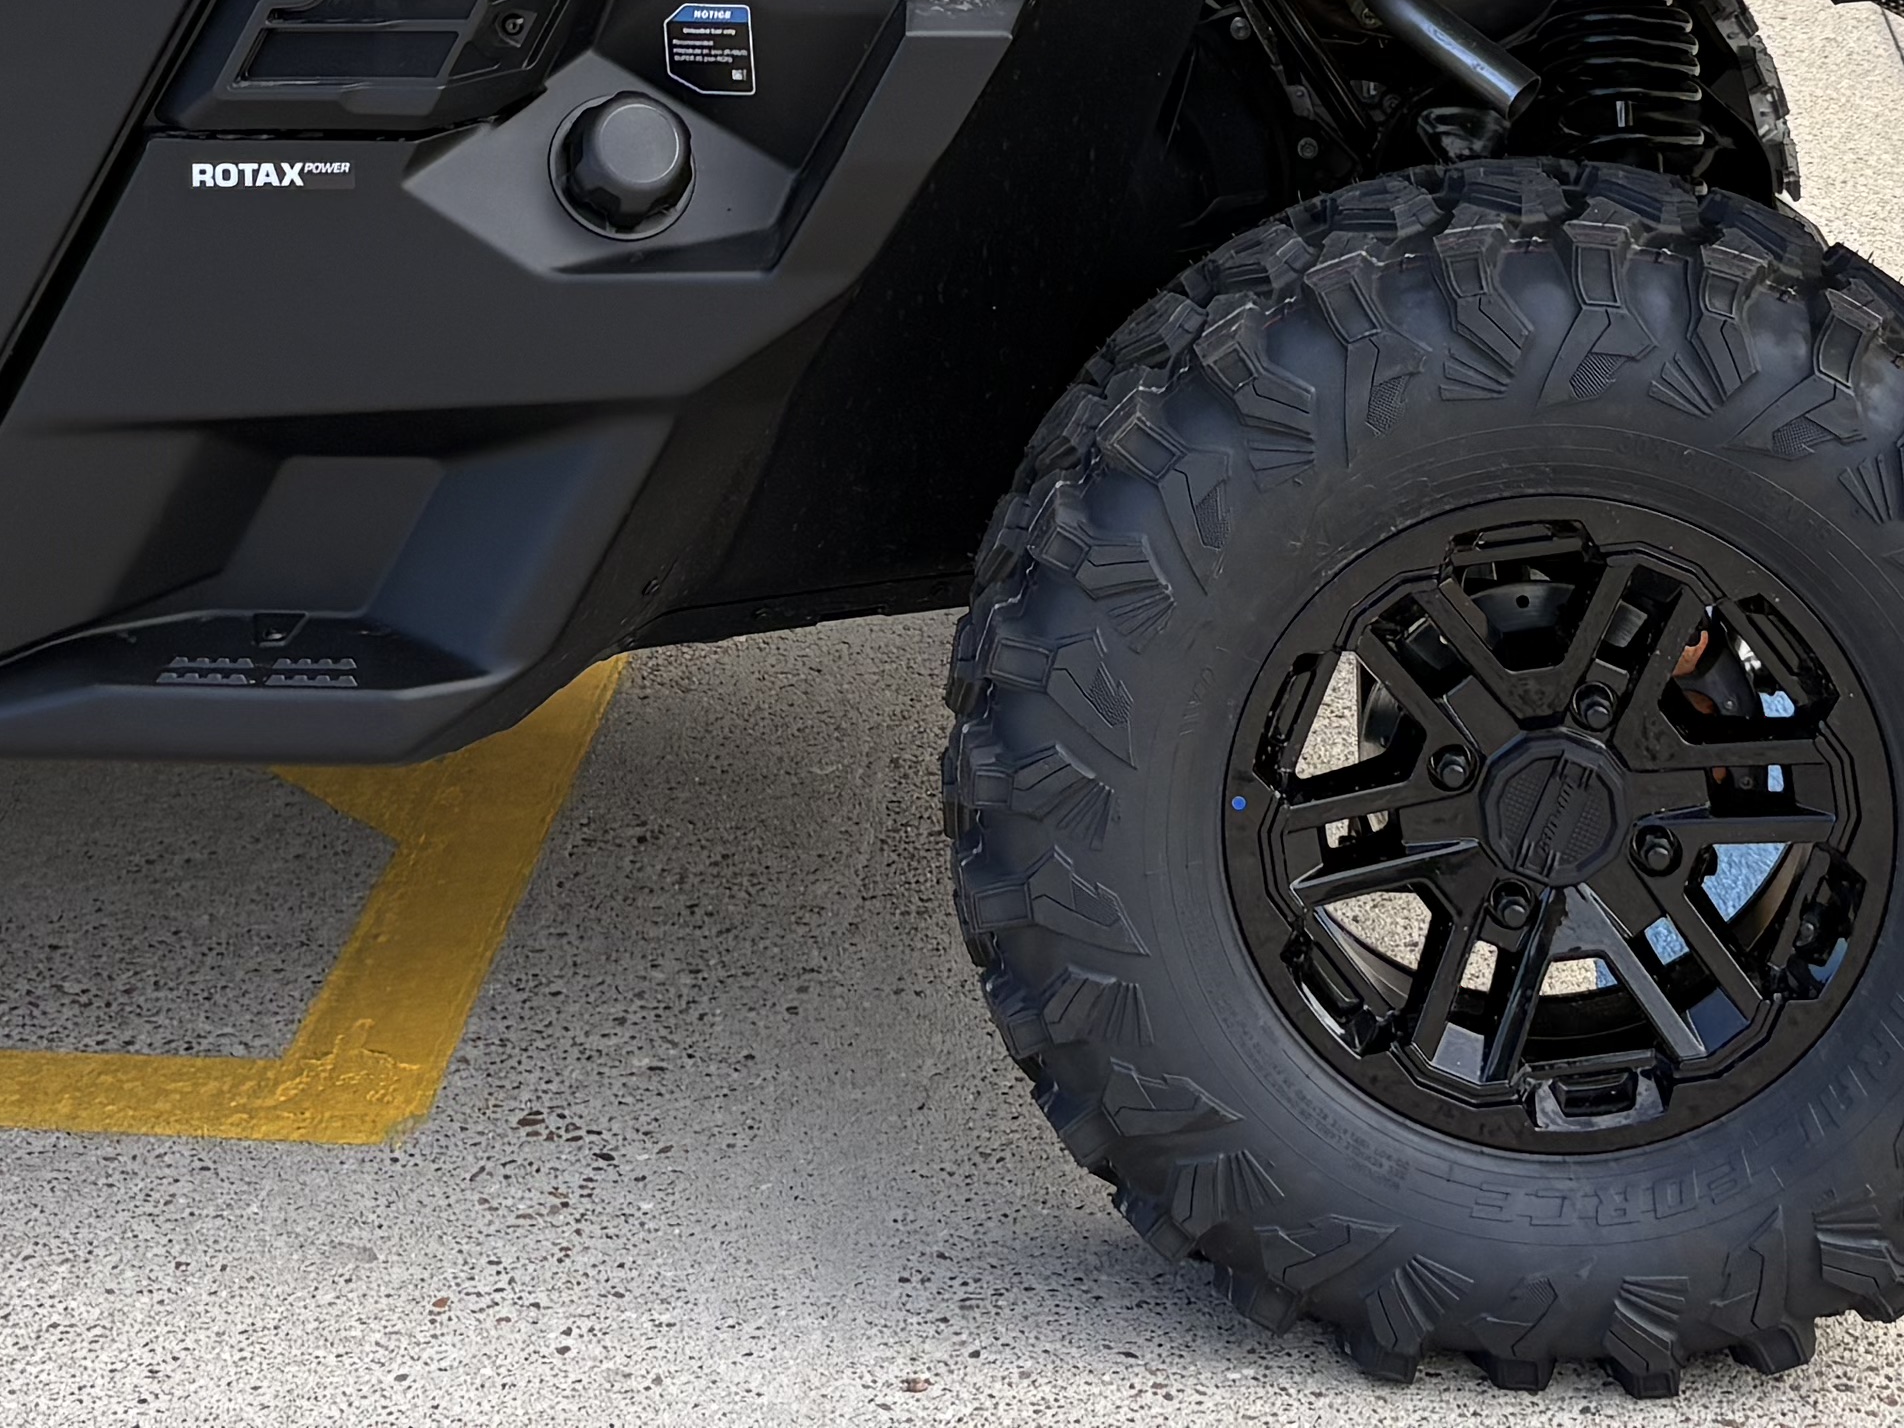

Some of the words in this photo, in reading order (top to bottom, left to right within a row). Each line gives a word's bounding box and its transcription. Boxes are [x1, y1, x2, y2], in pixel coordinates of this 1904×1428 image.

[693, 9, 732, 19] NOTICE
[192, 162, 304, 187] ROTAX
[304, 162, 351, 174] POWER
